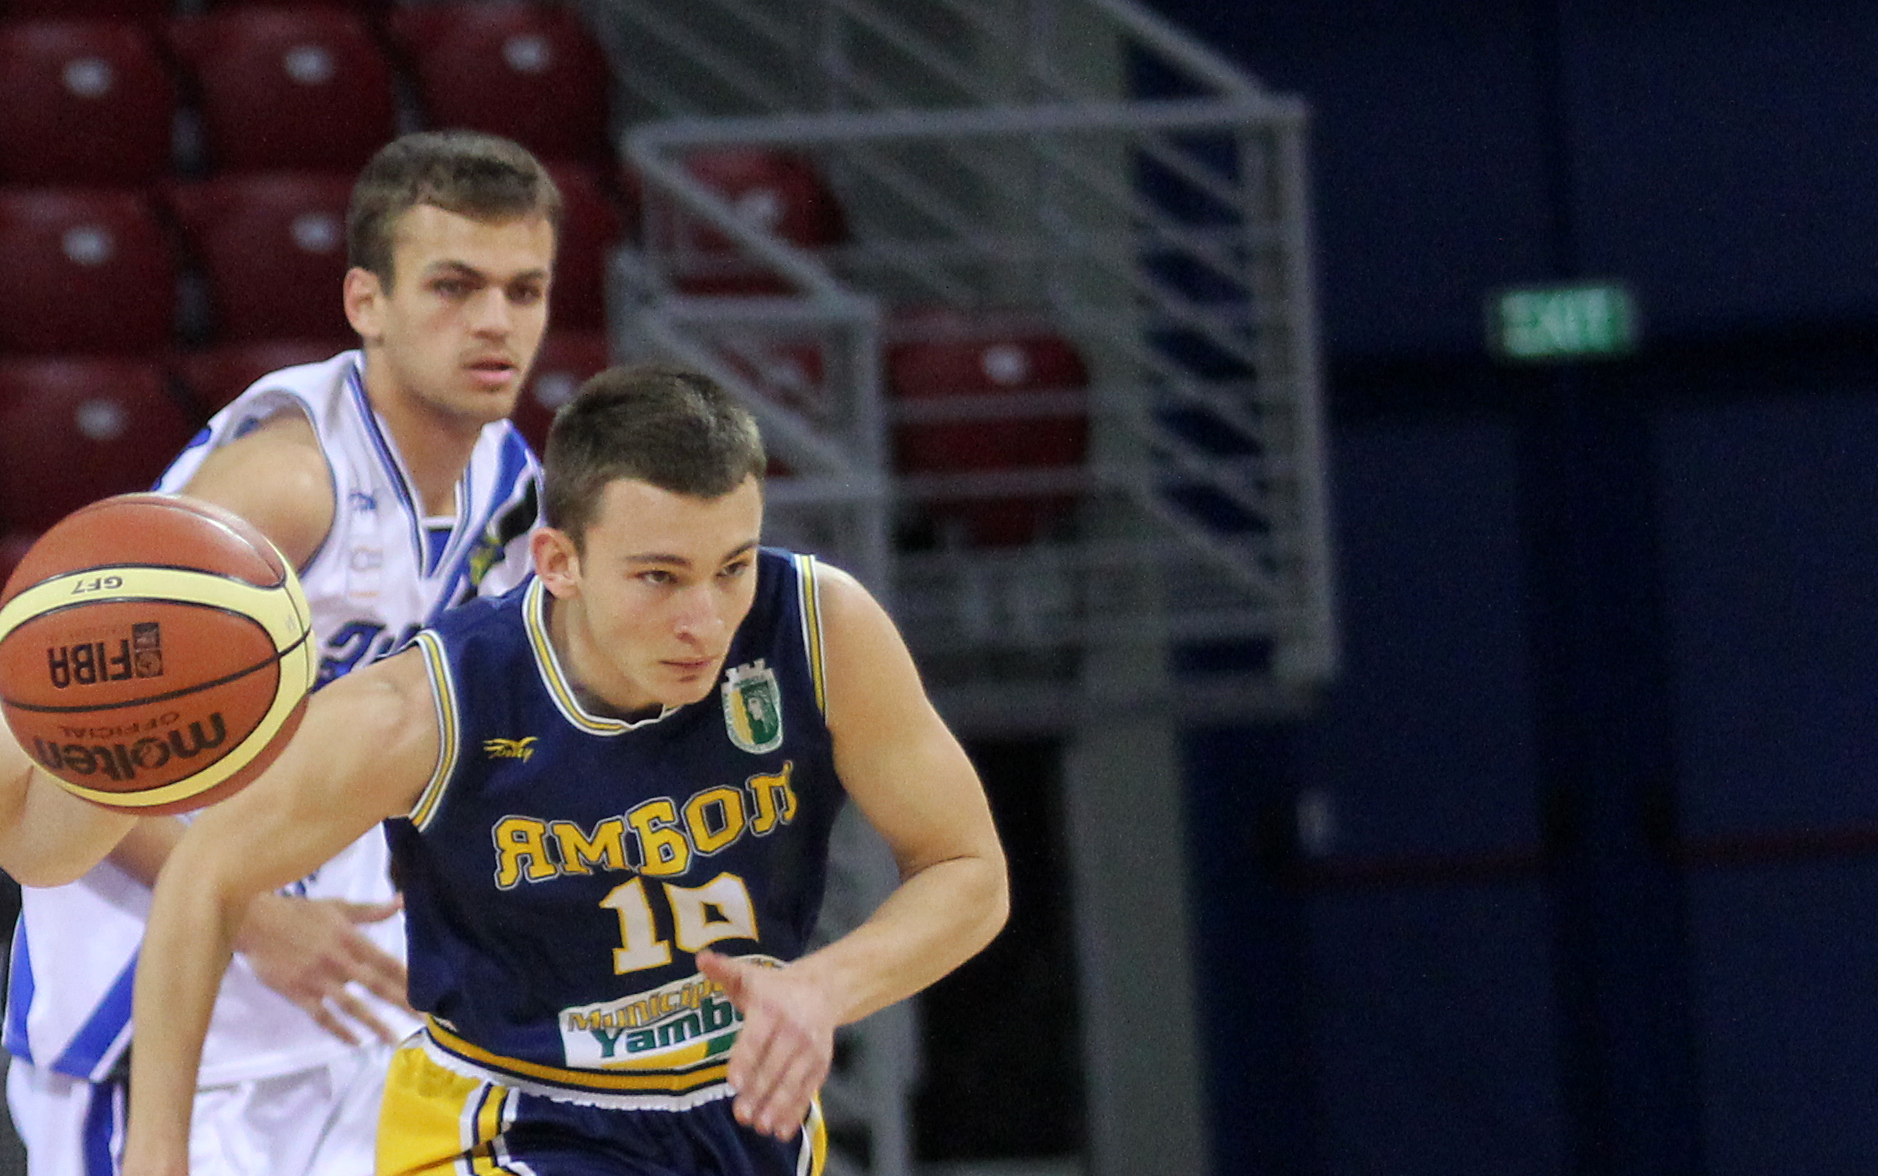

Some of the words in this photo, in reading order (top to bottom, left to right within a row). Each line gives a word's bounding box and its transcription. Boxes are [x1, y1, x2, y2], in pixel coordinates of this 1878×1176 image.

[1500, 286, 1614, 354] EXIT
[70, 575, 124, 595] GF7
[47, 638, 133, 690] FIBA
[32, 711, 228, 784] molten
[61, 711, 182, 740] OFFICIAL
[491, 760, 798, 890] ЯМБОЛ
